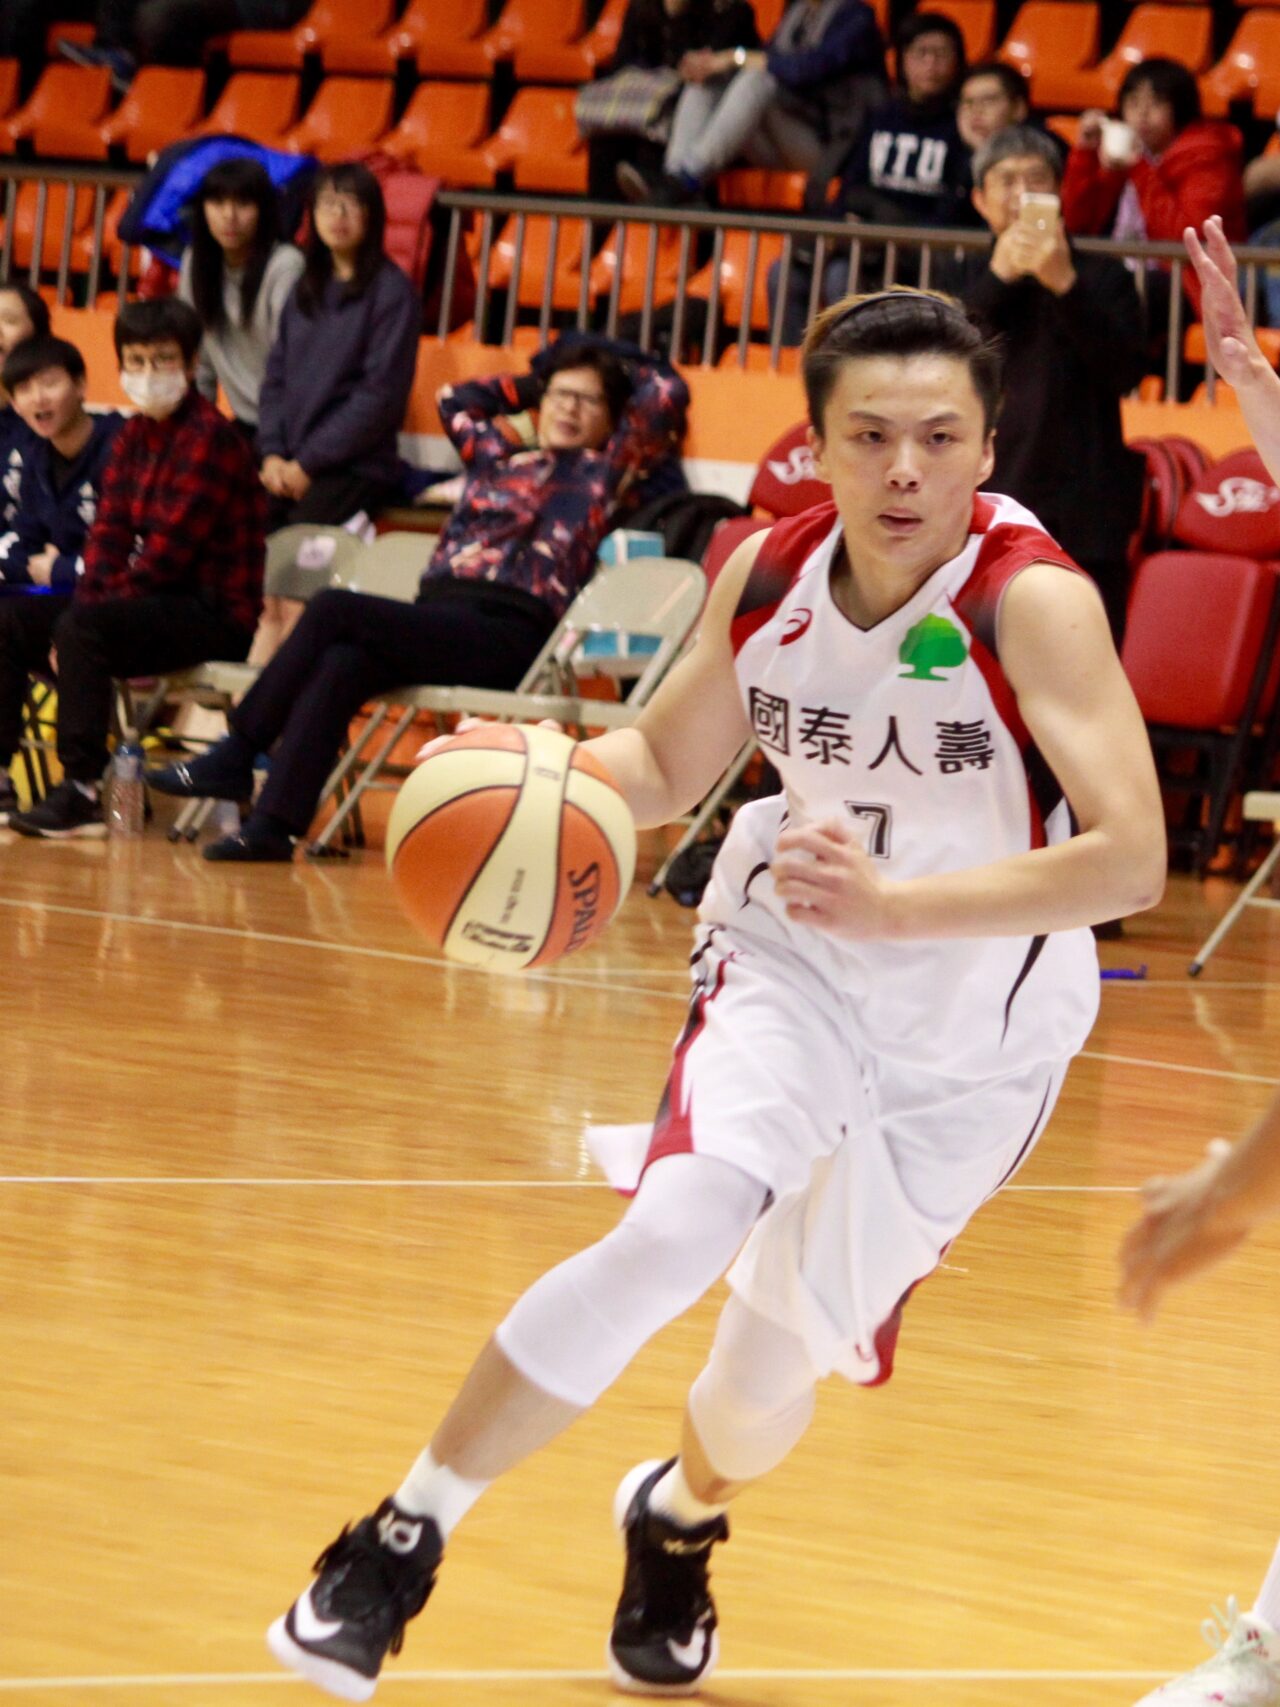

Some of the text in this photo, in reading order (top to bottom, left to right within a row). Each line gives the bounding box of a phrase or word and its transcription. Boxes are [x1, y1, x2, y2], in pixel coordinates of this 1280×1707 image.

[749, 686, 995, 778] 國泰人壽
[845, 800, 892, 859] 7
